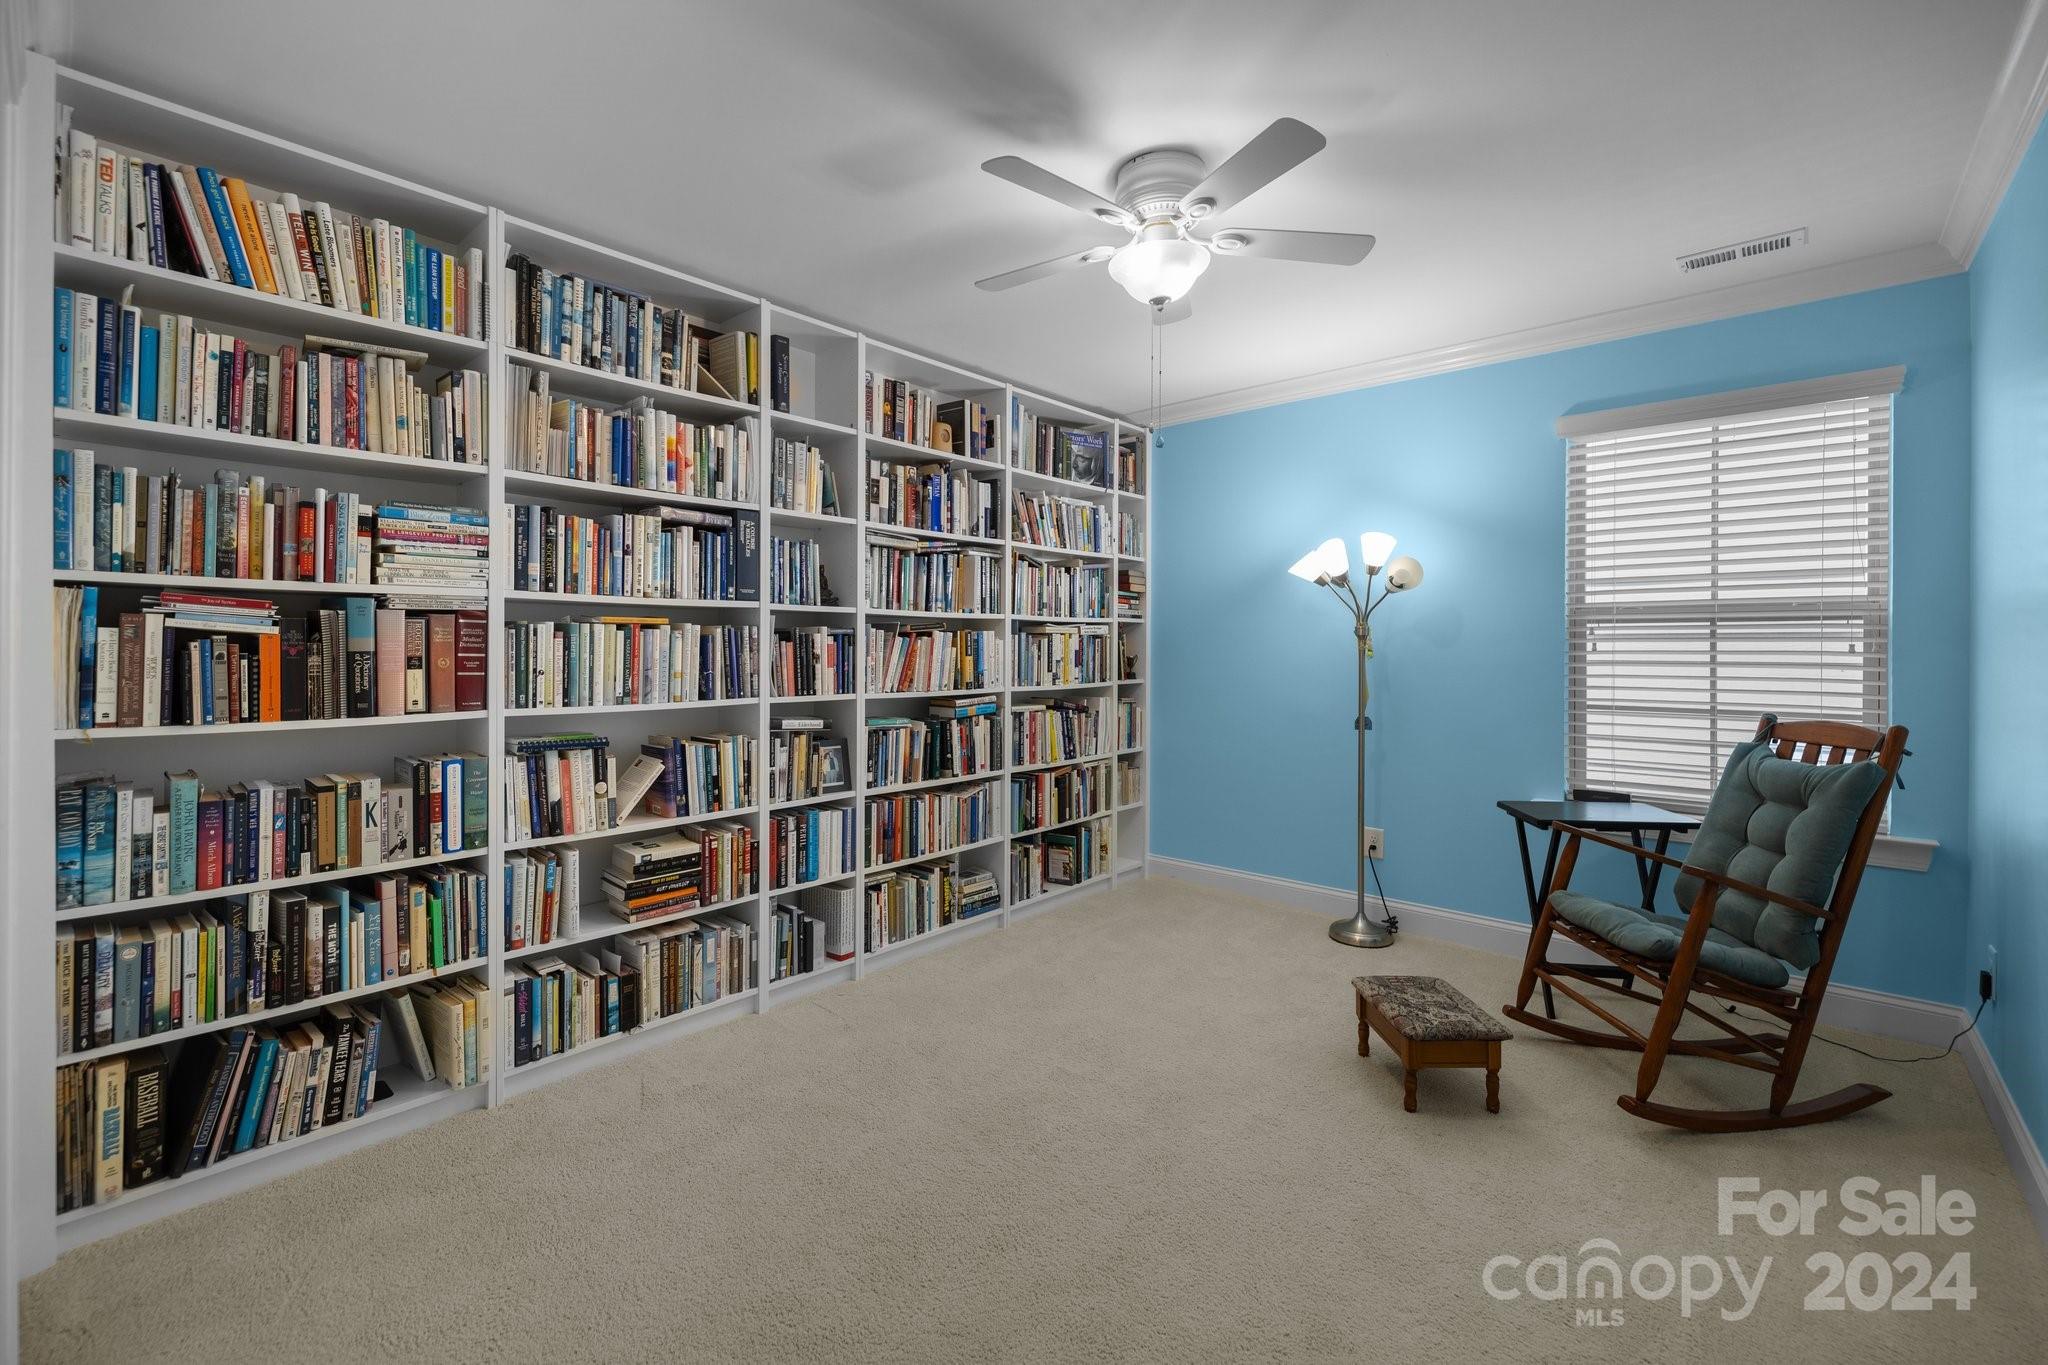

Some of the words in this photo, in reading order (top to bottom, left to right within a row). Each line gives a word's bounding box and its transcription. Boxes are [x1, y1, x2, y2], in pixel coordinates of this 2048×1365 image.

[100, 156, 114, 182] TED
[100, 183, 112, 214] TALKS
[242, 204, 250, 220] never
[246, 222, 254, 232] eat
[250, 234, 259, 252] alone
[308, 216, 318, 228] Life
[323, 220, 331, 235] Late
[292, 215, 305, 240] TELL
[300, 249, 312, 270] WIN
[311, 235, 321, 252] Good
[326, 236, 336, 268] Bloomers
[457, 266, 466, 290] send
[354, 661, 362, 693] Quotations
[362, 660, 370, 690] Dictionary
[59, 789, 82, 806] PAT
[184, 800, 194, 825] JOHN
[59, 812, 82, 848] CONROY
[97, 822, 105, 834] PAT
[183, 828, 193, 862] IRVING
[207, 841, 216, 861] Mitch
[207, 863, 215, 885] Albom
[233, 905, 241, 913] A
[231, 913, 241, 944] Velocity
[328, 923, 336, 939] THE
[233, 946, 243, 954] of
[328, 941, 337, 963] MOTH
[63, 955, 71, 977] PRICE
[230, 956, 241, 978] Being
[62, 989, 70, 1007] TIME
[336, 1032, 351, 1060] YANKEE
[333, 1060, 348, 1083] YEARS
[137, 1072, 159, 1128] BASEBALL
[103, 1107, 120, 1161] BASEBALL
